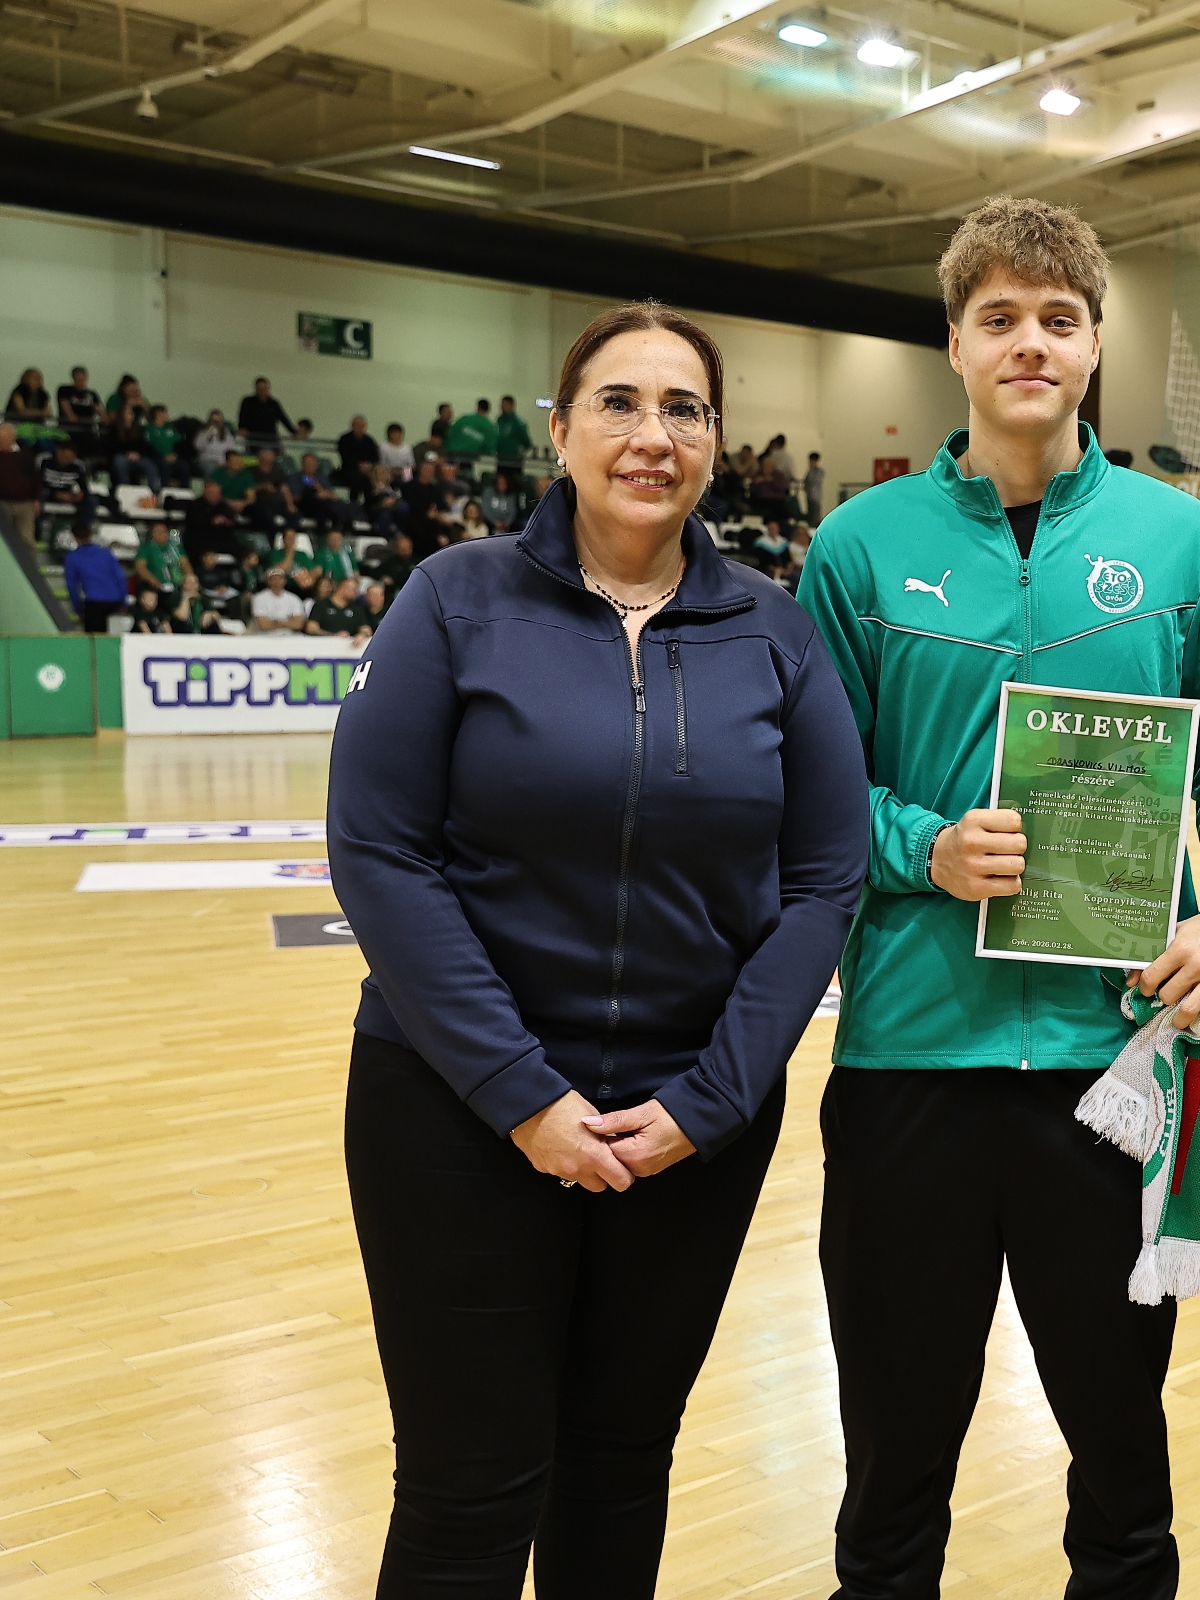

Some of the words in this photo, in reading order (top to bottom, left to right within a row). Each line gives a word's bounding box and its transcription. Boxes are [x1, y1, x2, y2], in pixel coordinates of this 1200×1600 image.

[344, 321, 364, 349] C
[1026, 710, 1172, 743] OKLEVÉL
[1107, 763, 1146, 774] VILMOS
[1071, 774, 1115, 786] részére
[1042, 889, 1063, 898] Rita
[1083, 893, 1136, 906] Kopornyik
[1140, 899, 1165, 908] Zsolt
